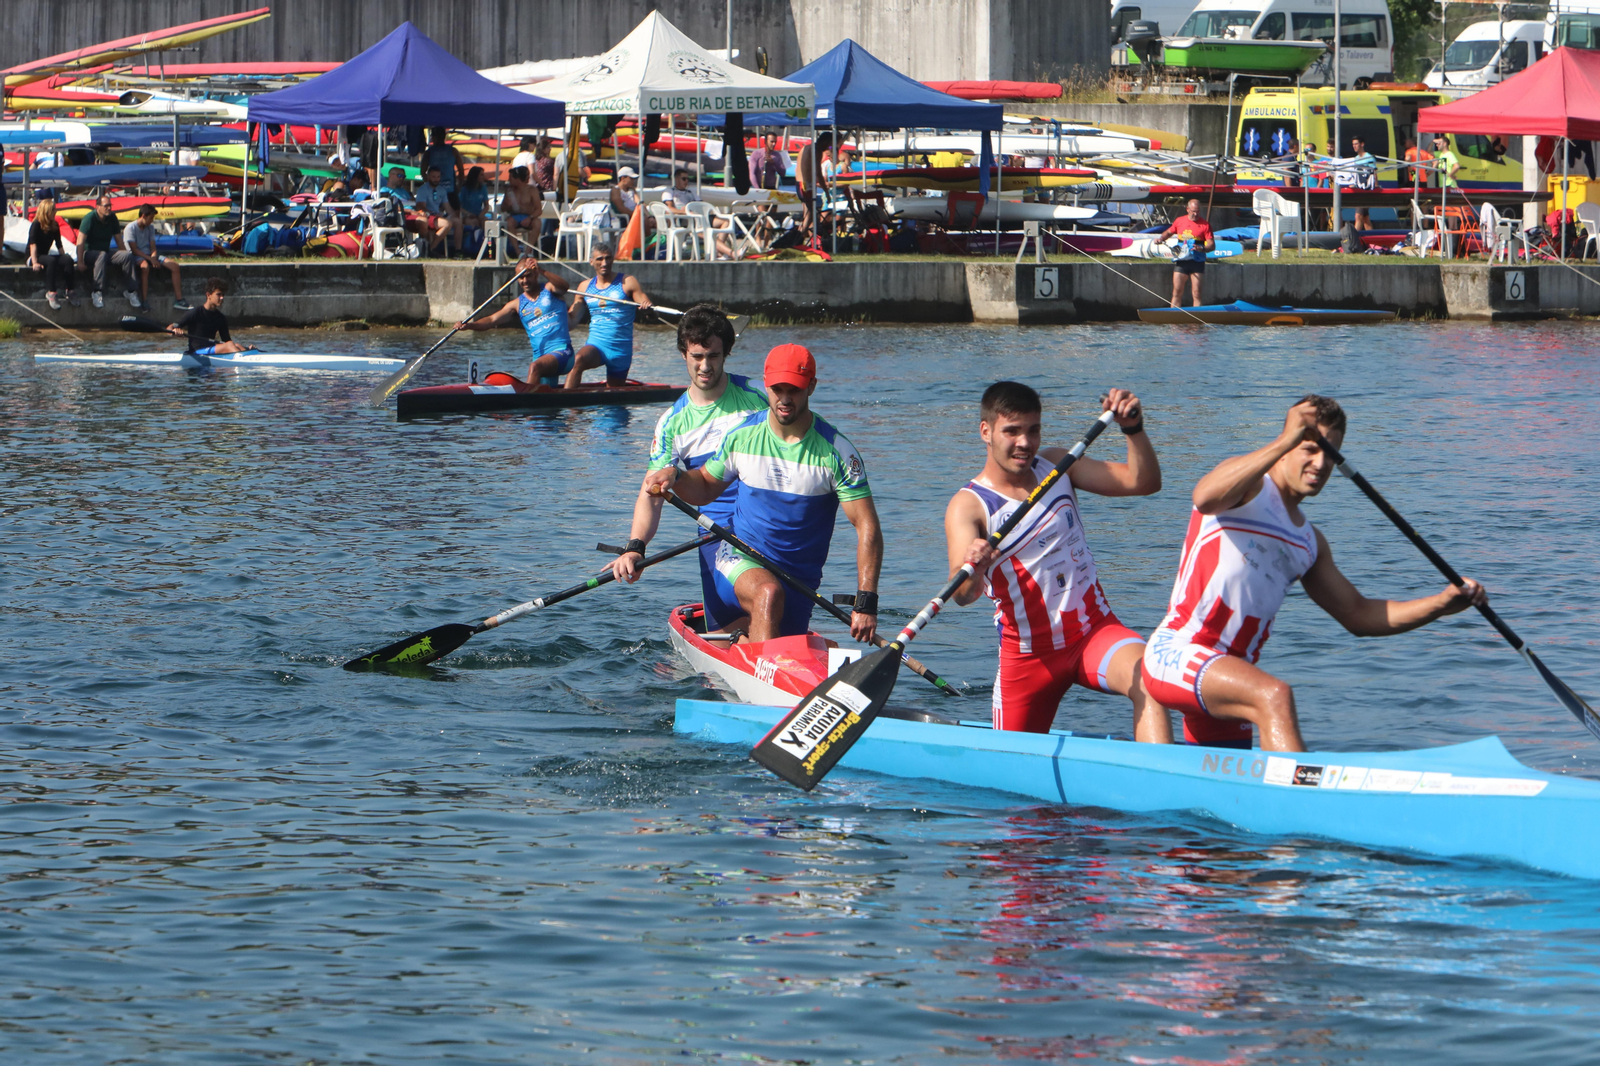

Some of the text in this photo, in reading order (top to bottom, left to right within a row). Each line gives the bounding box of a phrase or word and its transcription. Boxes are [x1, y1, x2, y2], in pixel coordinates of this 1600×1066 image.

[1346, 50, 1374, 60] Talavera
[573, 98, 632, 112] BETANZOS
[649, 94, 806, 111] CLUB RIA DE BETANZOS
[1244, 107, 1297, 116] AMBULANCIA
[1039, 268, 1054, 298] 5
[1509, 272, 1521, 299] 6
[470, 361, 478, 381] 6
[791, 698, 829, 734] PARAMOS
[804, 706, 842, 741] AXUDA
[1201, 753, 1266, 778] NELO
